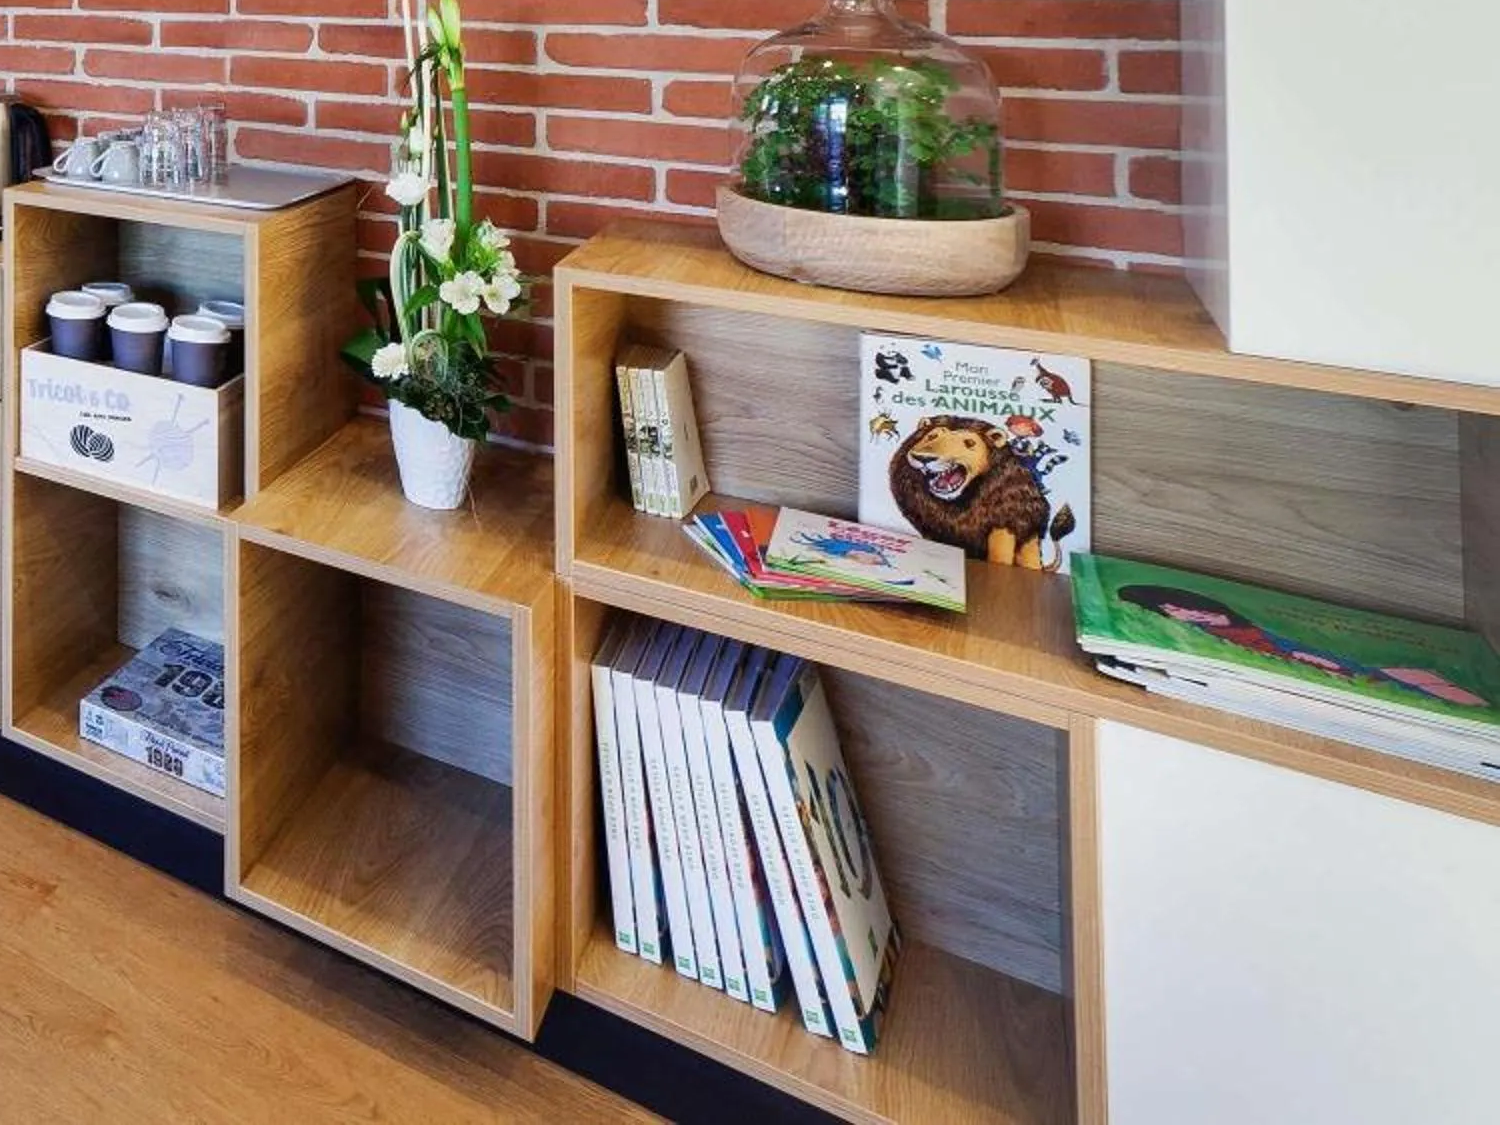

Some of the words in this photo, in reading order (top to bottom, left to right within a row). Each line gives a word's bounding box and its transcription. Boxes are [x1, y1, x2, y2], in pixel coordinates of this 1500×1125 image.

[943, 370, 1001, 387] Premier
[955, 362, 989, 375] Mon
[26, 378, 85, 405] Tricot
[925, 378, 1021, 403] Larousse
[891, 392, 927, 407] des
[932, 394, 1057, 423] ANIMAUX
